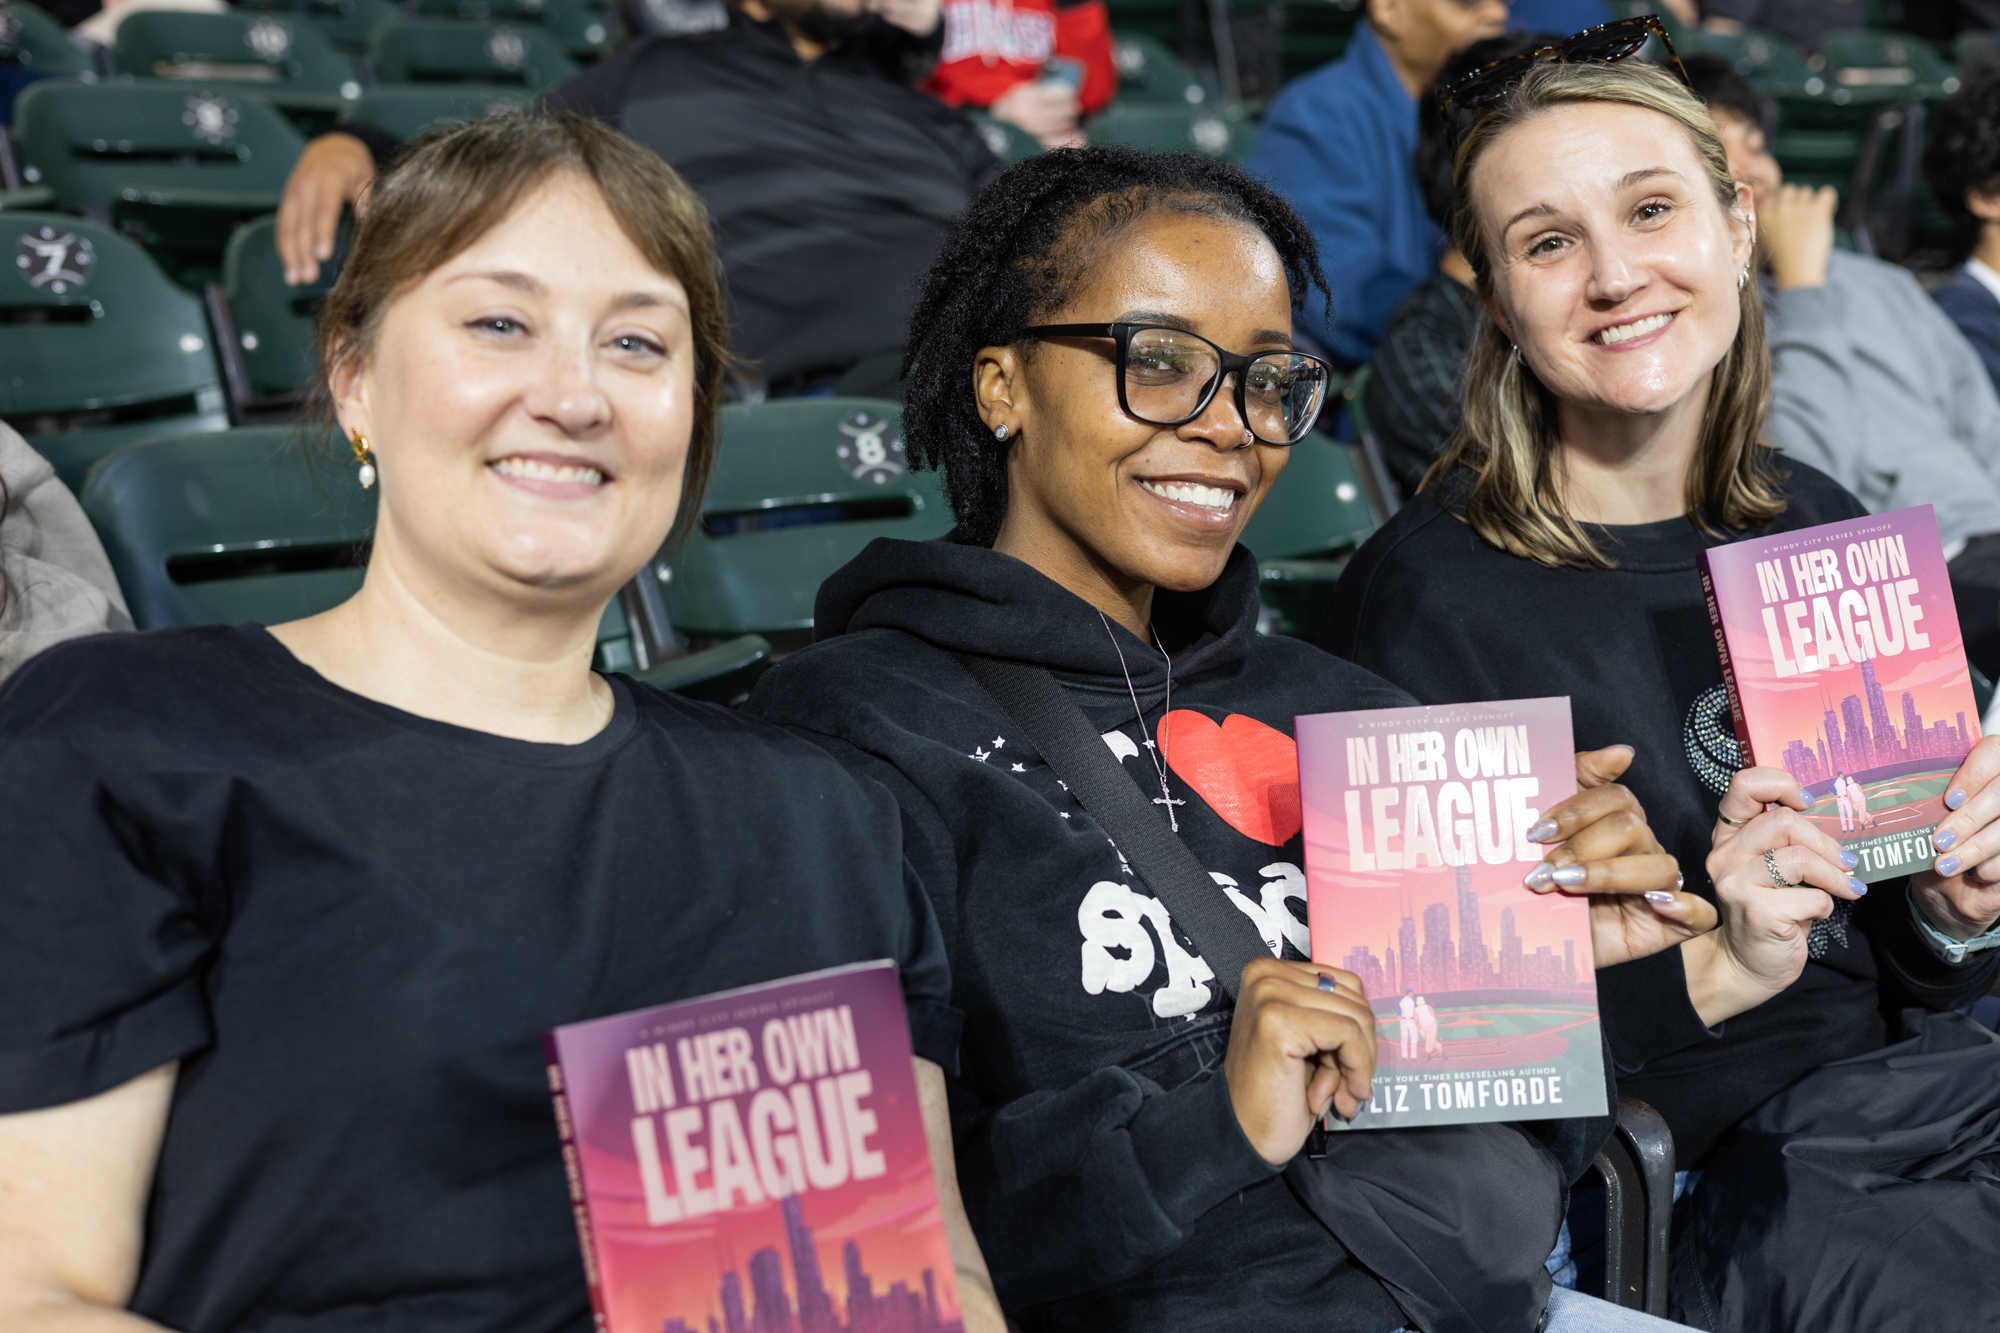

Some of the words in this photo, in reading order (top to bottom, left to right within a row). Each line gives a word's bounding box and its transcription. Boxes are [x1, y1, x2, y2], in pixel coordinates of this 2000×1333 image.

[34, 244, 68, 277] 7
[855, 431, 887, 465] 8
[1773, 542, 1799, 552] WINDY
[1804, 537, 1822, 546] CITY
[1826, 532, 1853, 541] SERIES
[1857, 524, 1892, 535] SPINOFF
[1702, 575, 1711, 592] IN
[1755, 558, 1789, 604] IN
[1790, 548, 1843, 597] HER
[1846, 534, 1910, 586] OWN
[1706, 596, 1718, 625] HER
[1761, 578, 1930, 678] LEAGUE
[1714, 628, 1728, 665] OWN
[1723, 668, 1742, 722] LEAGUE
[1473, 713, 1515, 721] SPINOFF
[1346, 736, 1379, 786] IN
[1387, 731, 1448, 782] HER
[1455, 725, 1531, 779] OWN
[1344, 777, 1544, 873] LEAGUE
[1861, 838, 1881, 847] TIMES
[1884, 827, 1930, 842] BESTSELLING
[1859, 834, 1937, 872] TOMFO
[626, 1042, 676, 1114] IN
[678, 1027, 760, 1102] HER
[762, 1005, 860, 1085] OWN
[1372, 1076, 1392, 1084] NEW
[1396, 1075, 1420, 1083] YORK
[1424, 1073, 1451, 1081] TIMES
[1454, 1069, 1515, 1079] BESTSELLING
[1519, 1067, 1556, 1076] AUTHOR
[1370, 1085, 1409, 1114] LIZ
[1420, 1076, 1563, 1111] TOMFORDE
[631, 1070, 887, 1226] LEAGUE
